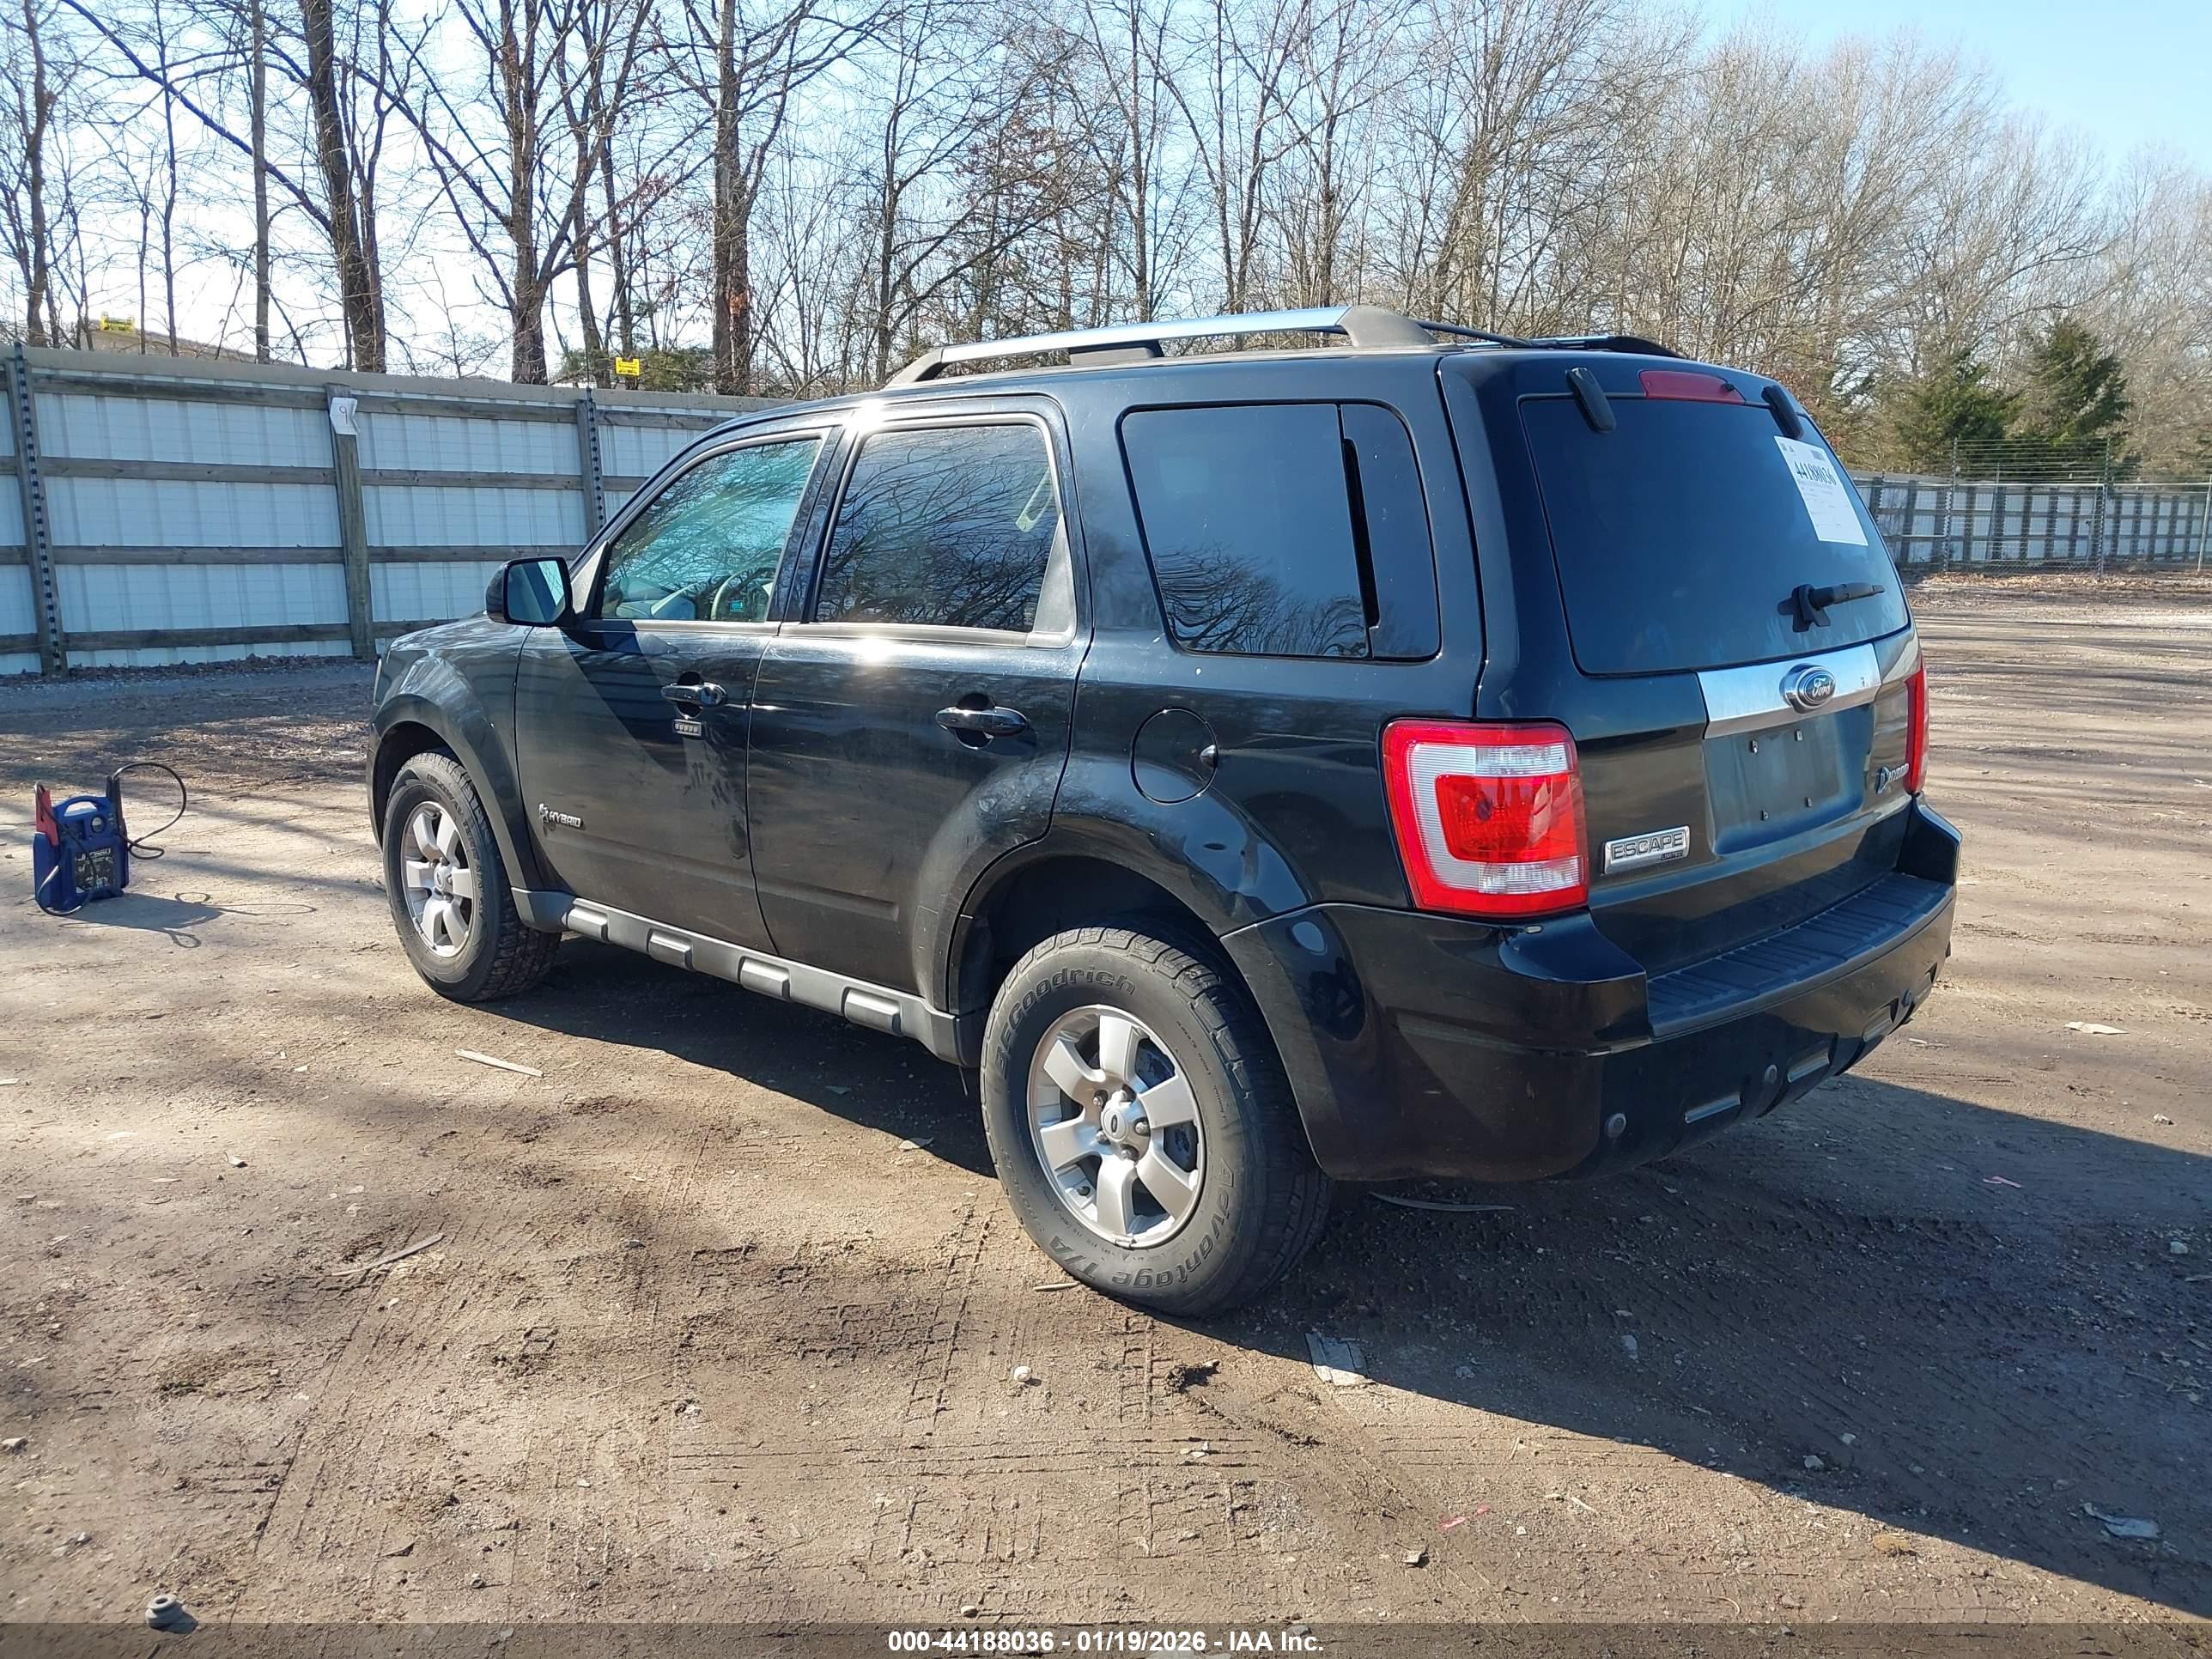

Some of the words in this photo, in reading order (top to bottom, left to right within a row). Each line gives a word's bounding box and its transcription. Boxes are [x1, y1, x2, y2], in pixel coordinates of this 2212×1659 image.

[1794, 460, 1837, 486] 44188036
[1812, 677, 1834, 698] Ford
[550, 811, 582, 828] HYBRID
[1611, 831, 1684, 861] ESCAPE
[996, 966, 1136, 1079] BFGoodrich
[1111, 1156, 1235, 1288] Advantage
[1048, 1235, 1101, 1280] T/A
